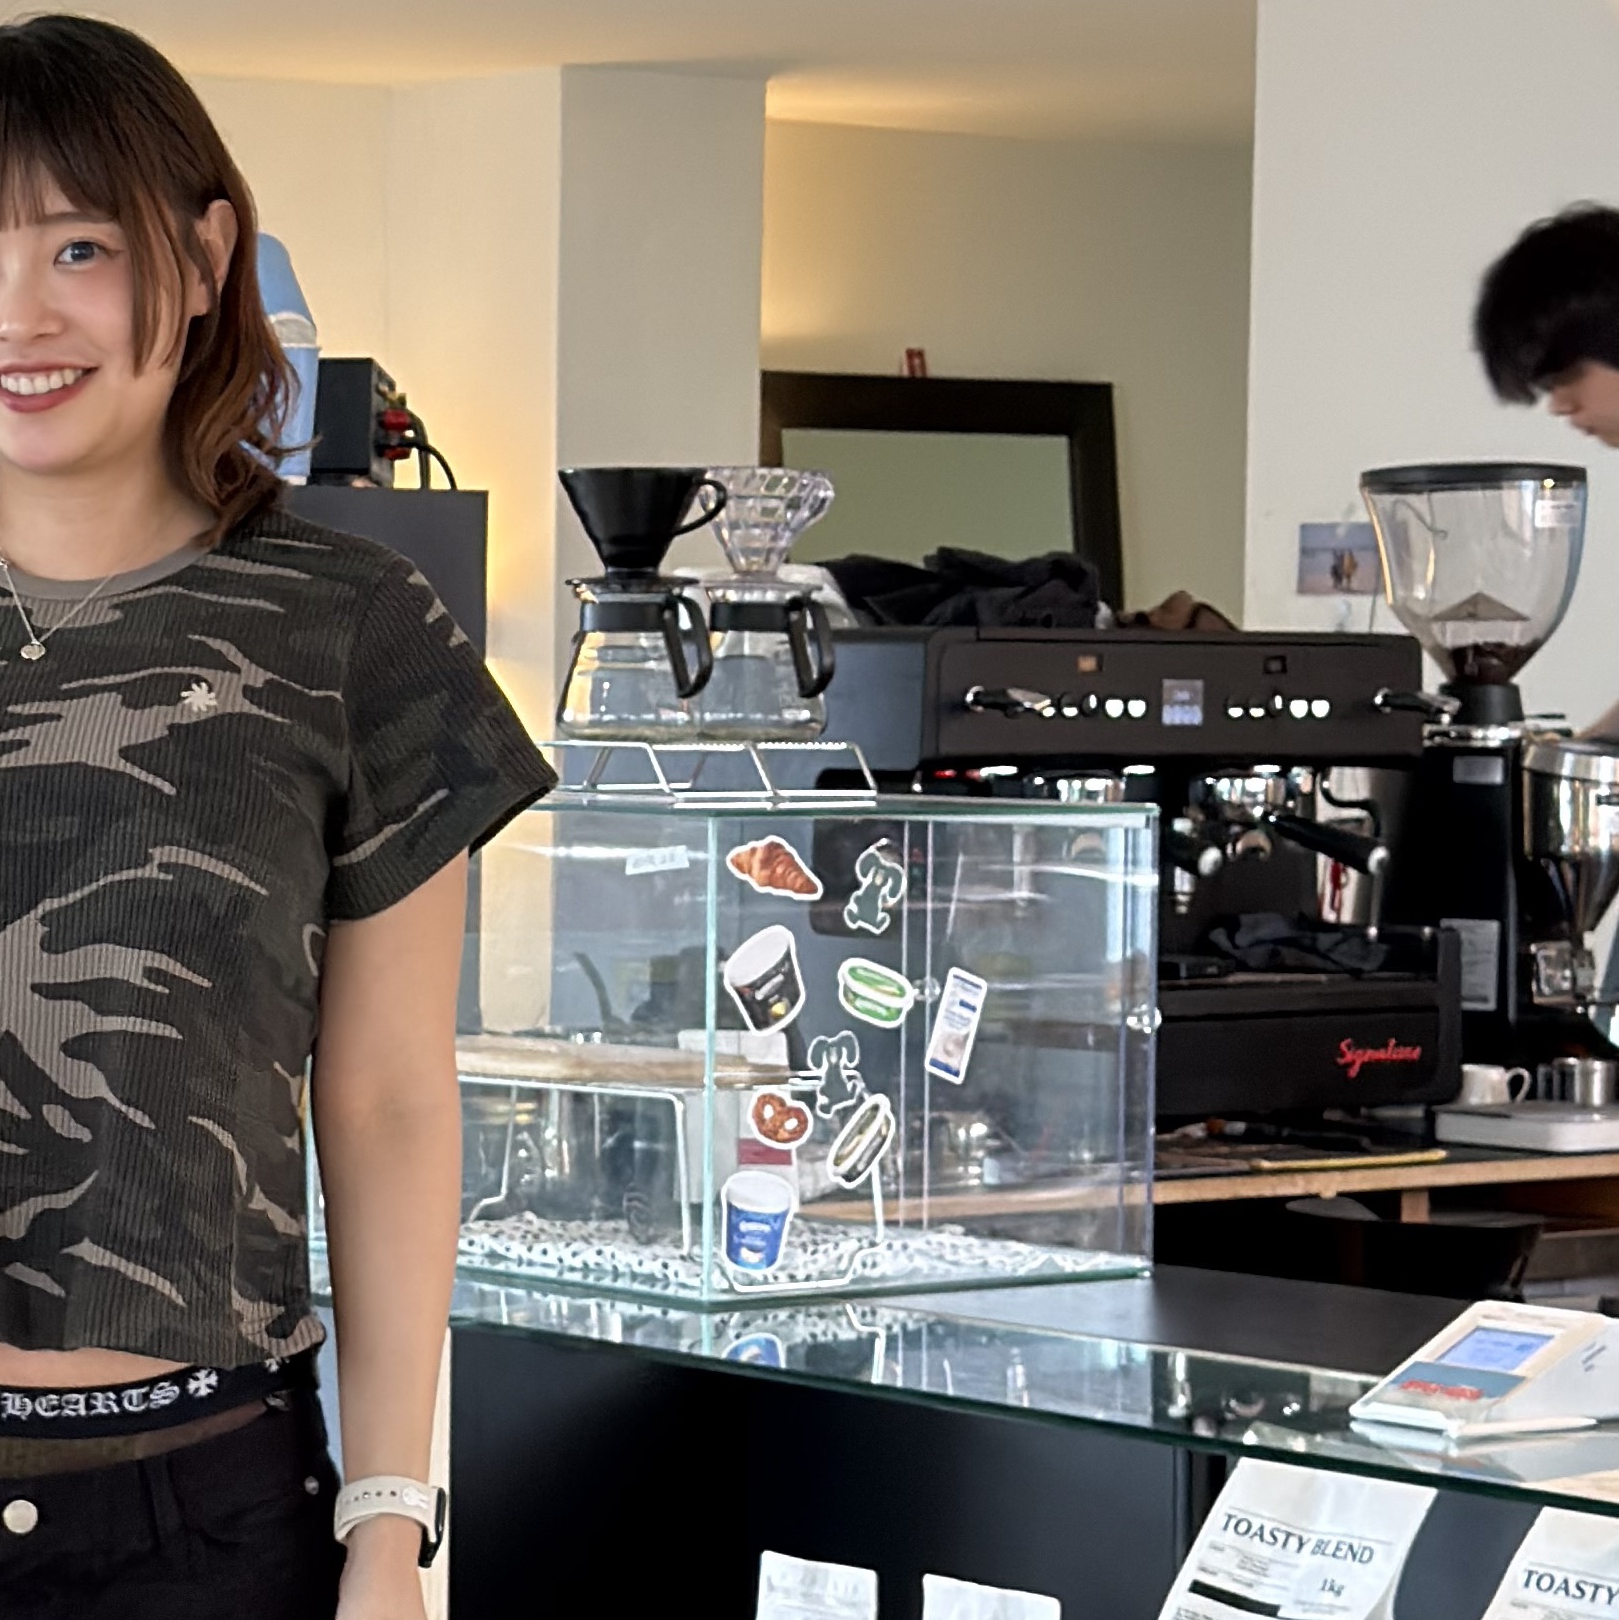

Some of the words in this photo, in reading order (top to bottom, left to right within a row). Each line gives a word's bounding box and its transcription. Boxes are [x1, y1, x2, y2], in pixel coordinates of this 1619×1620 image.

[1, 1381, 180, 1421] HEARTS
[1222, 1513, 1311, 1554] TOASTY
[1310, 1537, 1375, 1565] BLEND
[1320, 1577, 1346, 1598] 1kg
[1523, 1568, 1619, 1606] TOASTY
